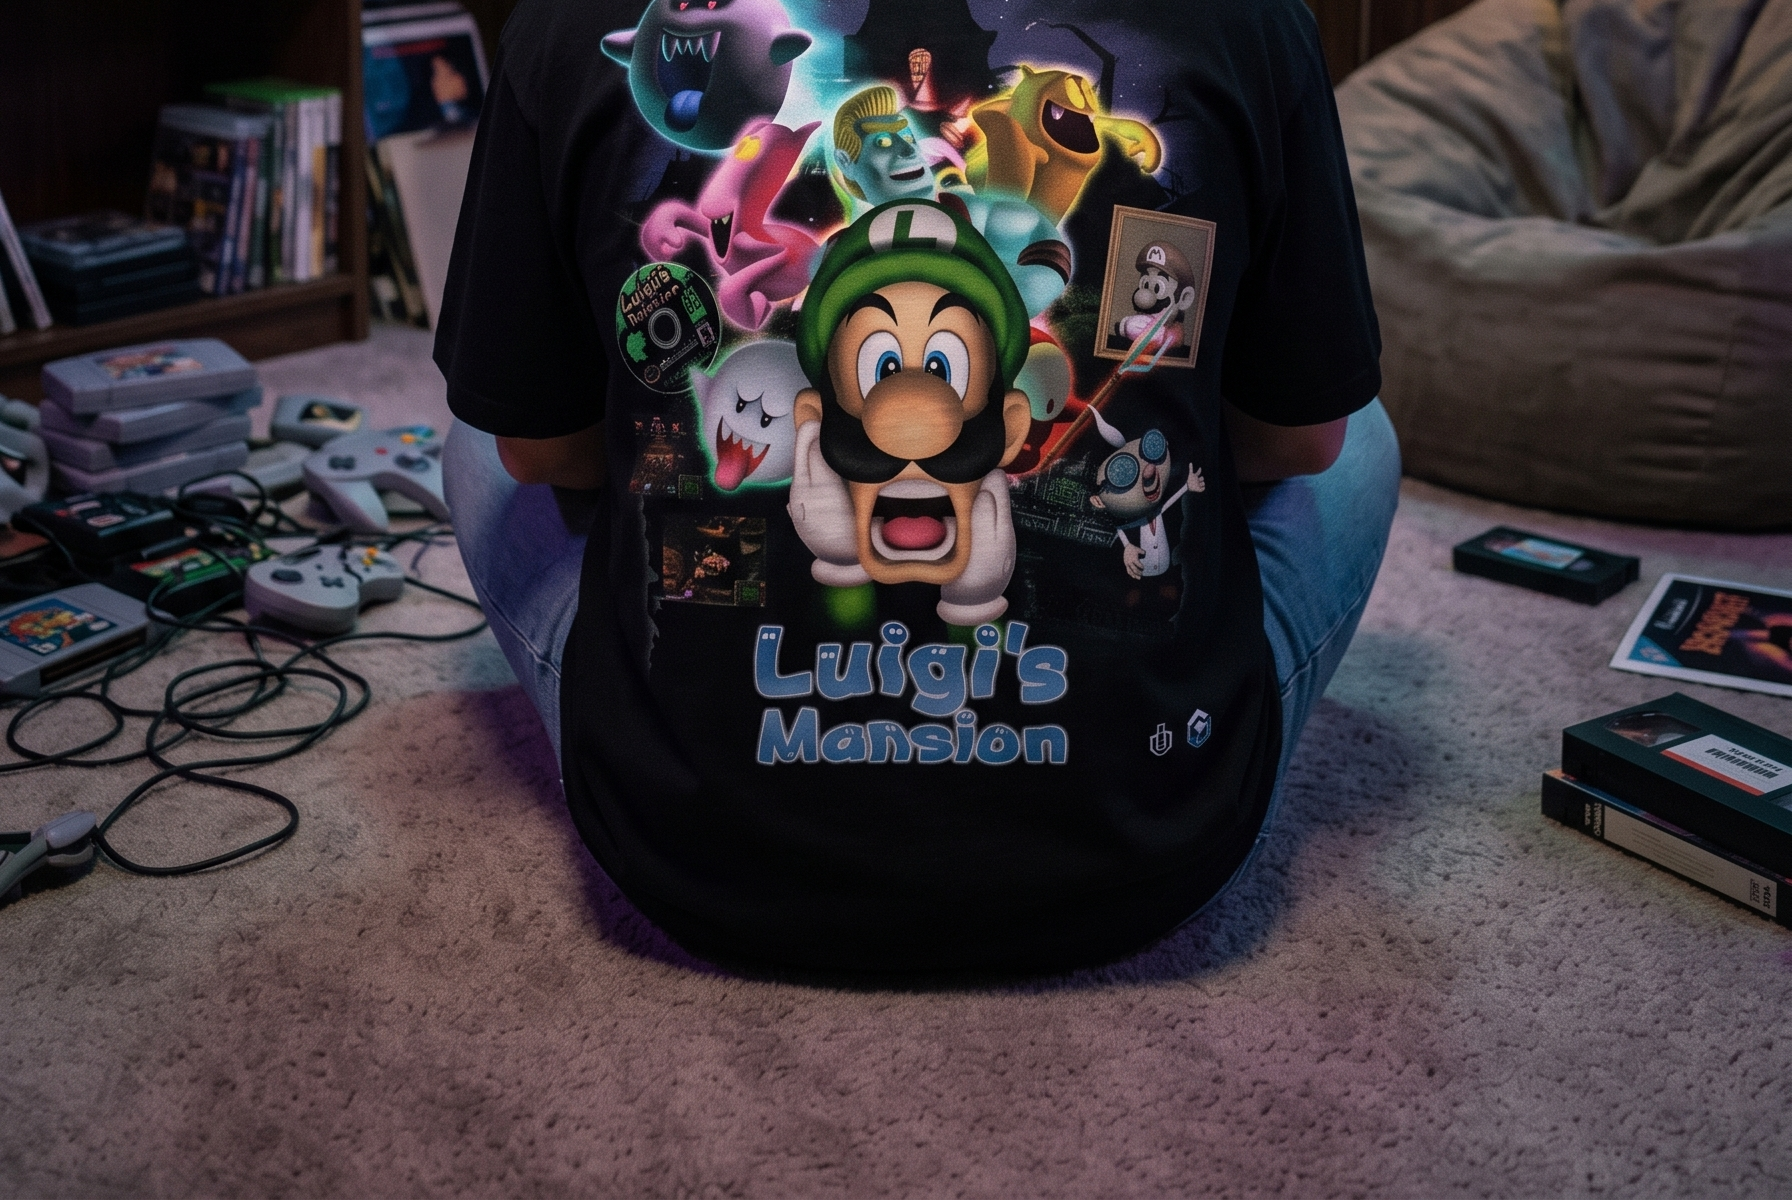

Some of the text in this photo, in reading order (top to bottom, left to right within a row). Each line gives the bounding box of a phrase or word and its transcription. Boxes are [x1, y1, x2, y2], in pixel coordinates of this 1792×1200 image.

[892, 210, 937, 250] L
[1148, 248, 1162, 261] M
[754, 621, 1068, 716] Luigi's
[756, 707, 1068, 765] Mansion
